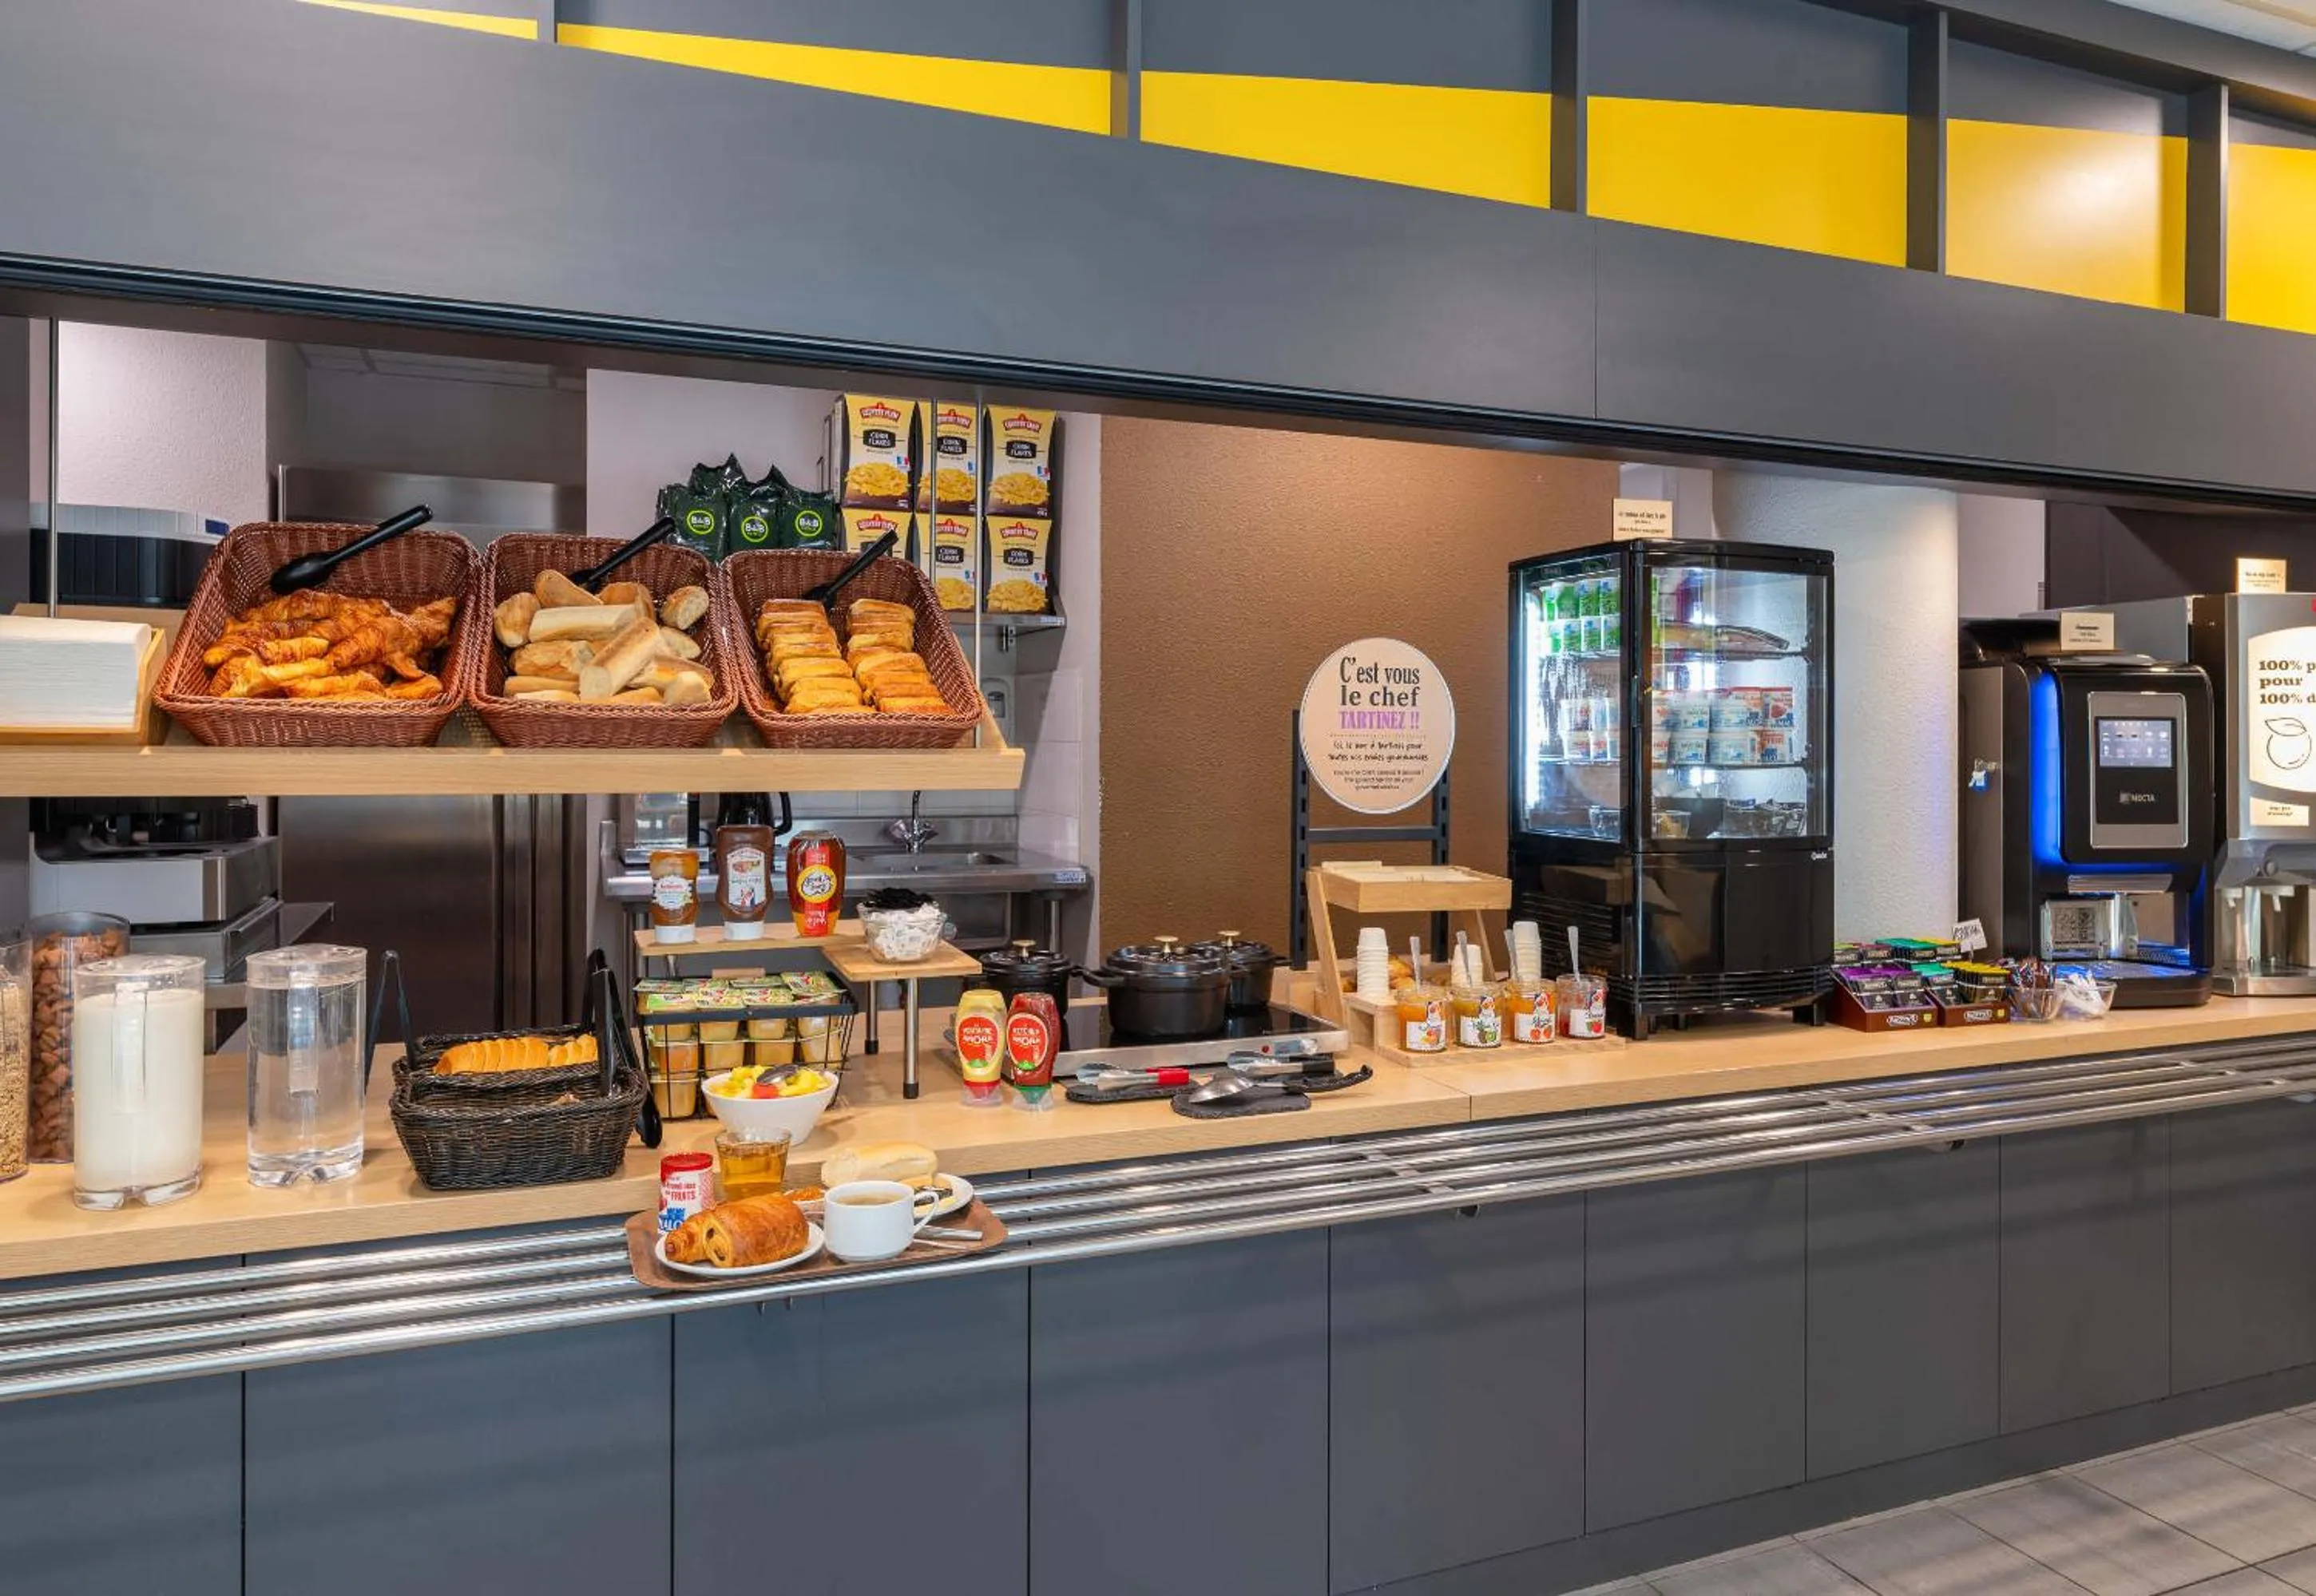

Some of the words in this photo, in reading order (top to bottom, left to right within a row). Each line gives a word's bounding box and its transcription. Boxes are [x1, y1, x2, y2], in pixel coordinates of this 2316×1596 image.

[1339, 656, 1379, 684] C'est
[1384, 666, 1421, 685] vous
[2258, 659, 2303, 671] 100%
[2259, 676, 2303, 689] pour
[1340, 685, 1362, 706] le
[1369, 685, 1422, 707] chef
[2259, 691, 2303, 705] 100%
[1339, 711, 1406, 731] TARTINEZ
